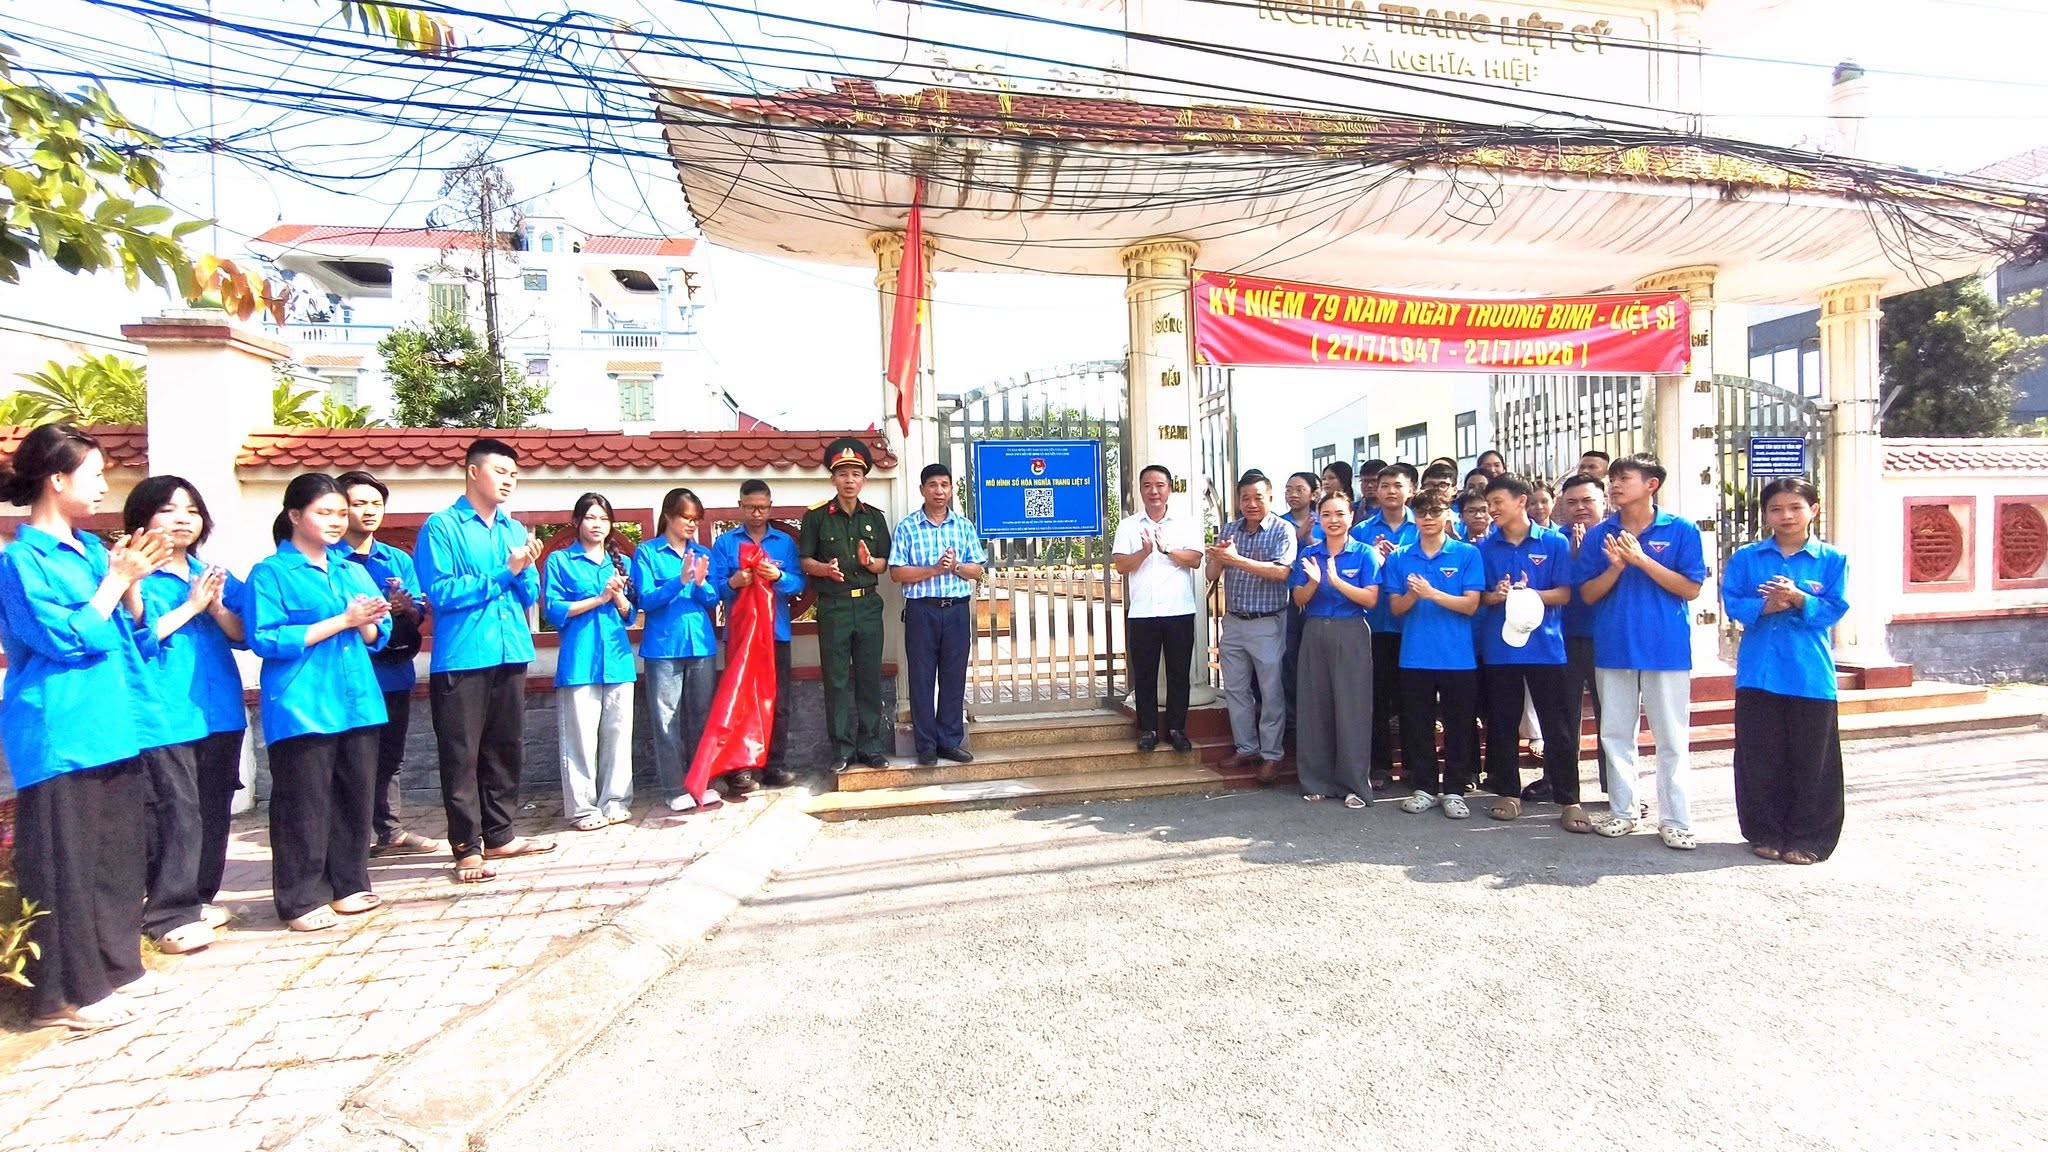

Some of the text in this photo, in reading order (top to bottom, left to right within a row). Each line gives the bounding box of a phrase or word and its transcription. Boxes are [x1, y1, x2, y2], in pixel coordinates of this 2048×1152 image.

[1378, 3, 1491, 43] TRANG
[1500, 12, 1564, 55] LIỆT
[1208, 279, 1238, 316] KỶ
[1245, 285, 1307, 325] NIỆM
[1311, 293, 1341, 321] 79
[1546, 303, 1598, 330] BINH
[1610, 300, 1650, 335] LIỆT
[1327, 333, 1441, 363] 27/7/1947
[1464, 339, 1574, 367] 27/7/2026
[1011, 477, 1020, 487] SỐ
[1033, 477, 1051, 487] NGHĨA
[1052, 478, 1071, 487] TRANG
[1071, 477, 1083, 487] LIỆT
